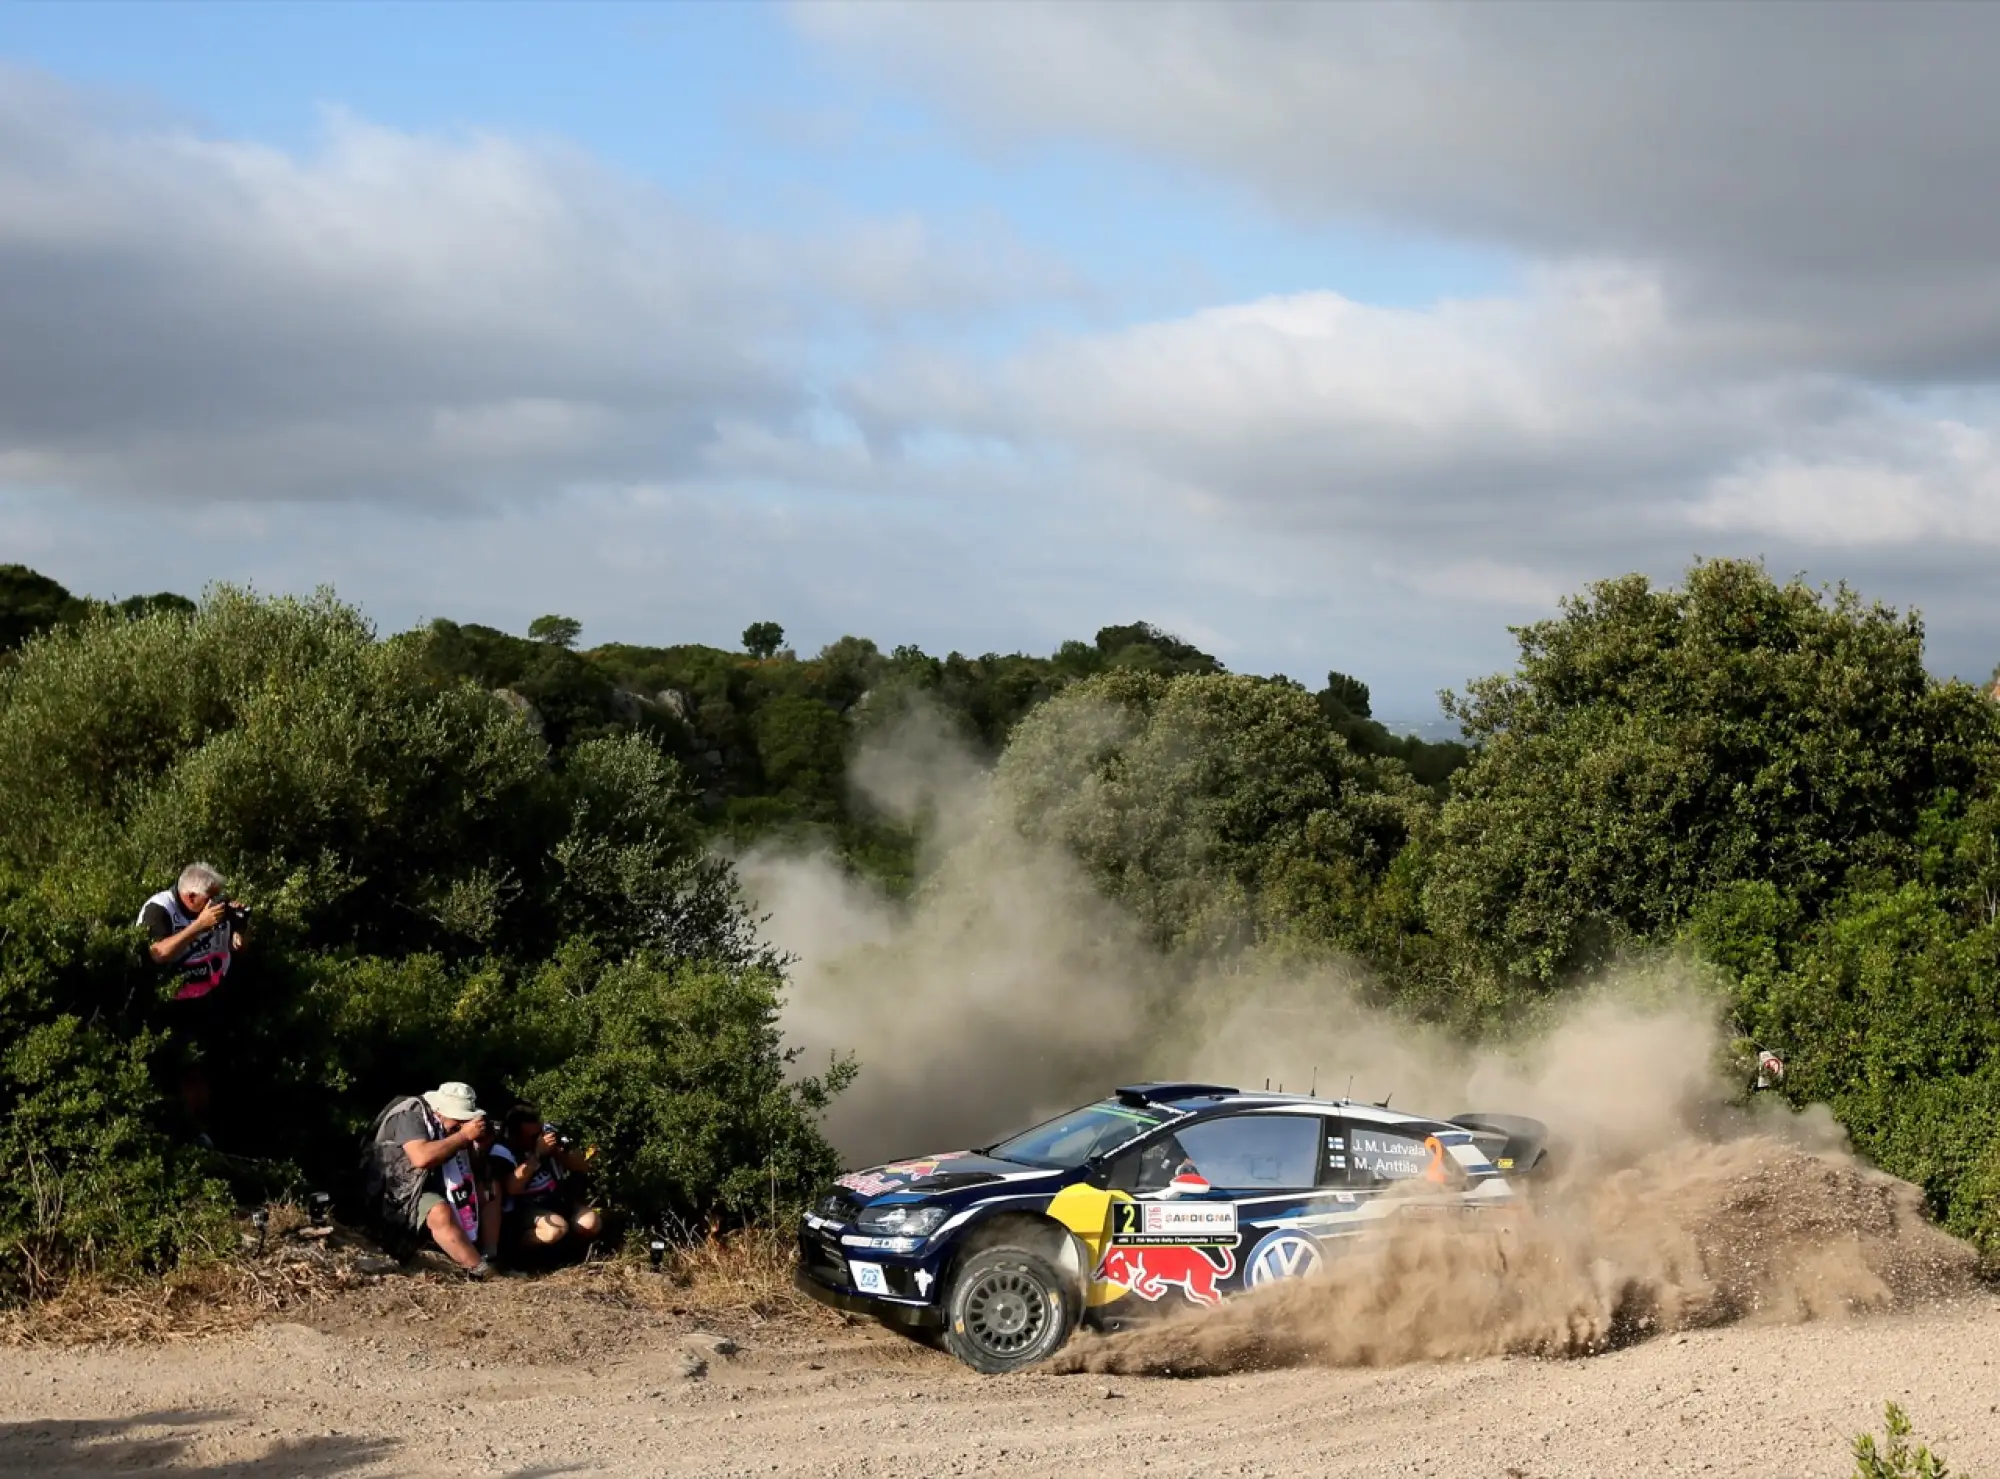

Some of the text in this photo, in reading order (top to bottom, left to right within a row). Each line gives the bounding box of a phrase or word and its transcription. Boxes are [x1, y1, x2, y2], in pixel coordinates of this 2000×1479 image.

[1382, 1141, 1426, 1157] Latvala
[1354, 1156, 1419, 1174] M. Anttila
[1122, 1204, 1136, 1233] 2
[1148, 1206, 1163, 1230] 2016
[1165, 1213, 1232, 1223] SARDEGNA
